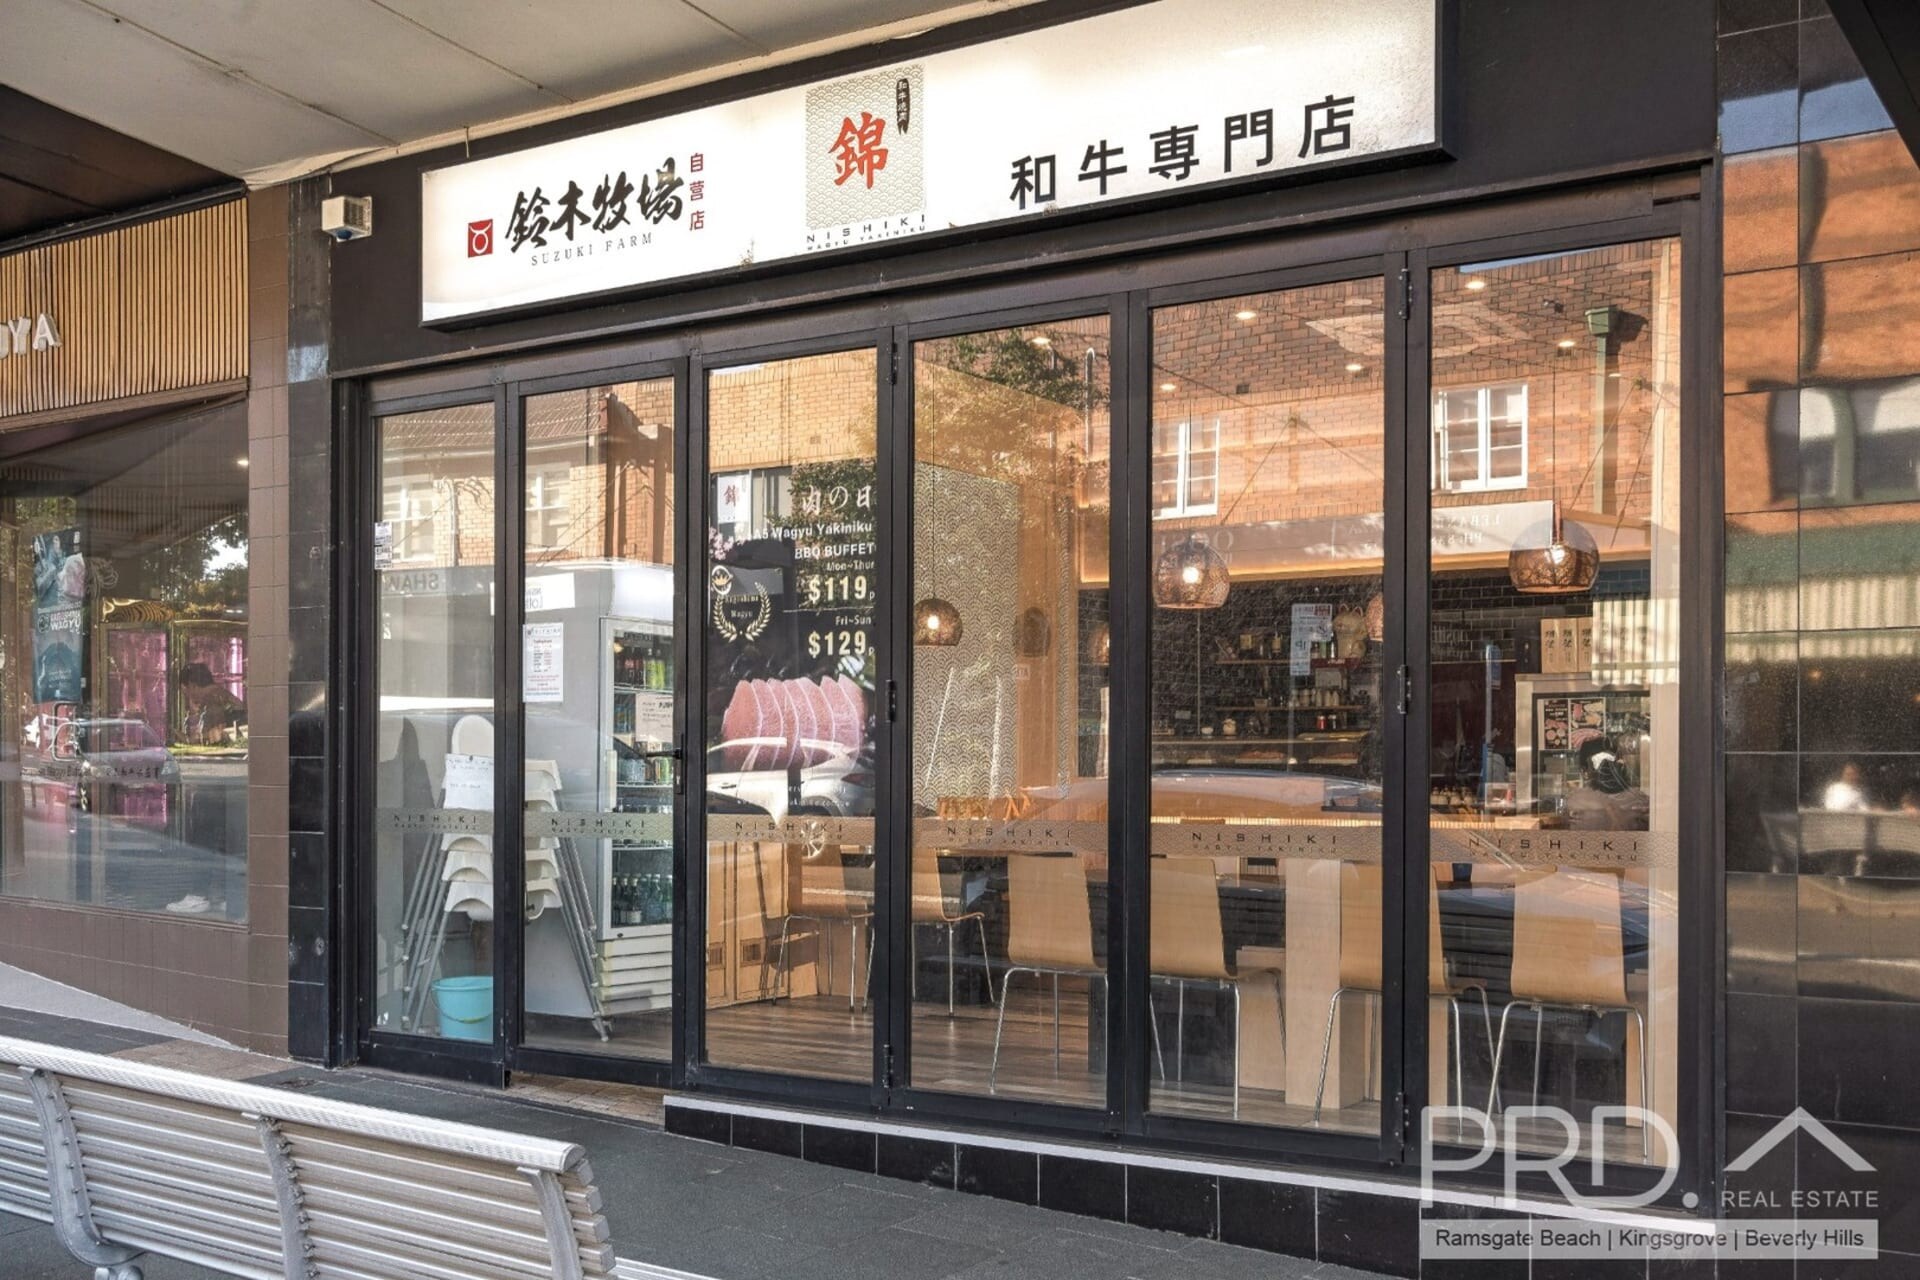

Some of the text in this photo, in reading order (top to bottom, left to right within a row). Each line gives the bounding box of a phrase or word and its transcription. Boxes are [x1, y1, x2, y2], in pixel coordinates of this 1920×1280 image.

[828, 111, 889, 190] 錦
[1009, 94, 1356, 210] 和牛専門店
[505, 157, 685, 253] 鈴木牧場
[807, 214, 925, 243] NISHIKI
[531, 232, 652, 266] SUZUKI FARM
[772, 525, 813, 541] Wagyu
[816, 520, 872, 536] Yakiniku
[795, 542, 875, 560] BBQ BUFFET
[808, 575, 867, 604] $119
[808, 630, 866, 659] $129
[551, 819, 645, 828] NISHIKI
[735, 822, 843, 832] NISHIKI
[947, 827, 1071, 838] NISHIKI
[1192, 832, 1337, 844] NISHIKI
[1468, 839, 1638, 851] NISHIKI
